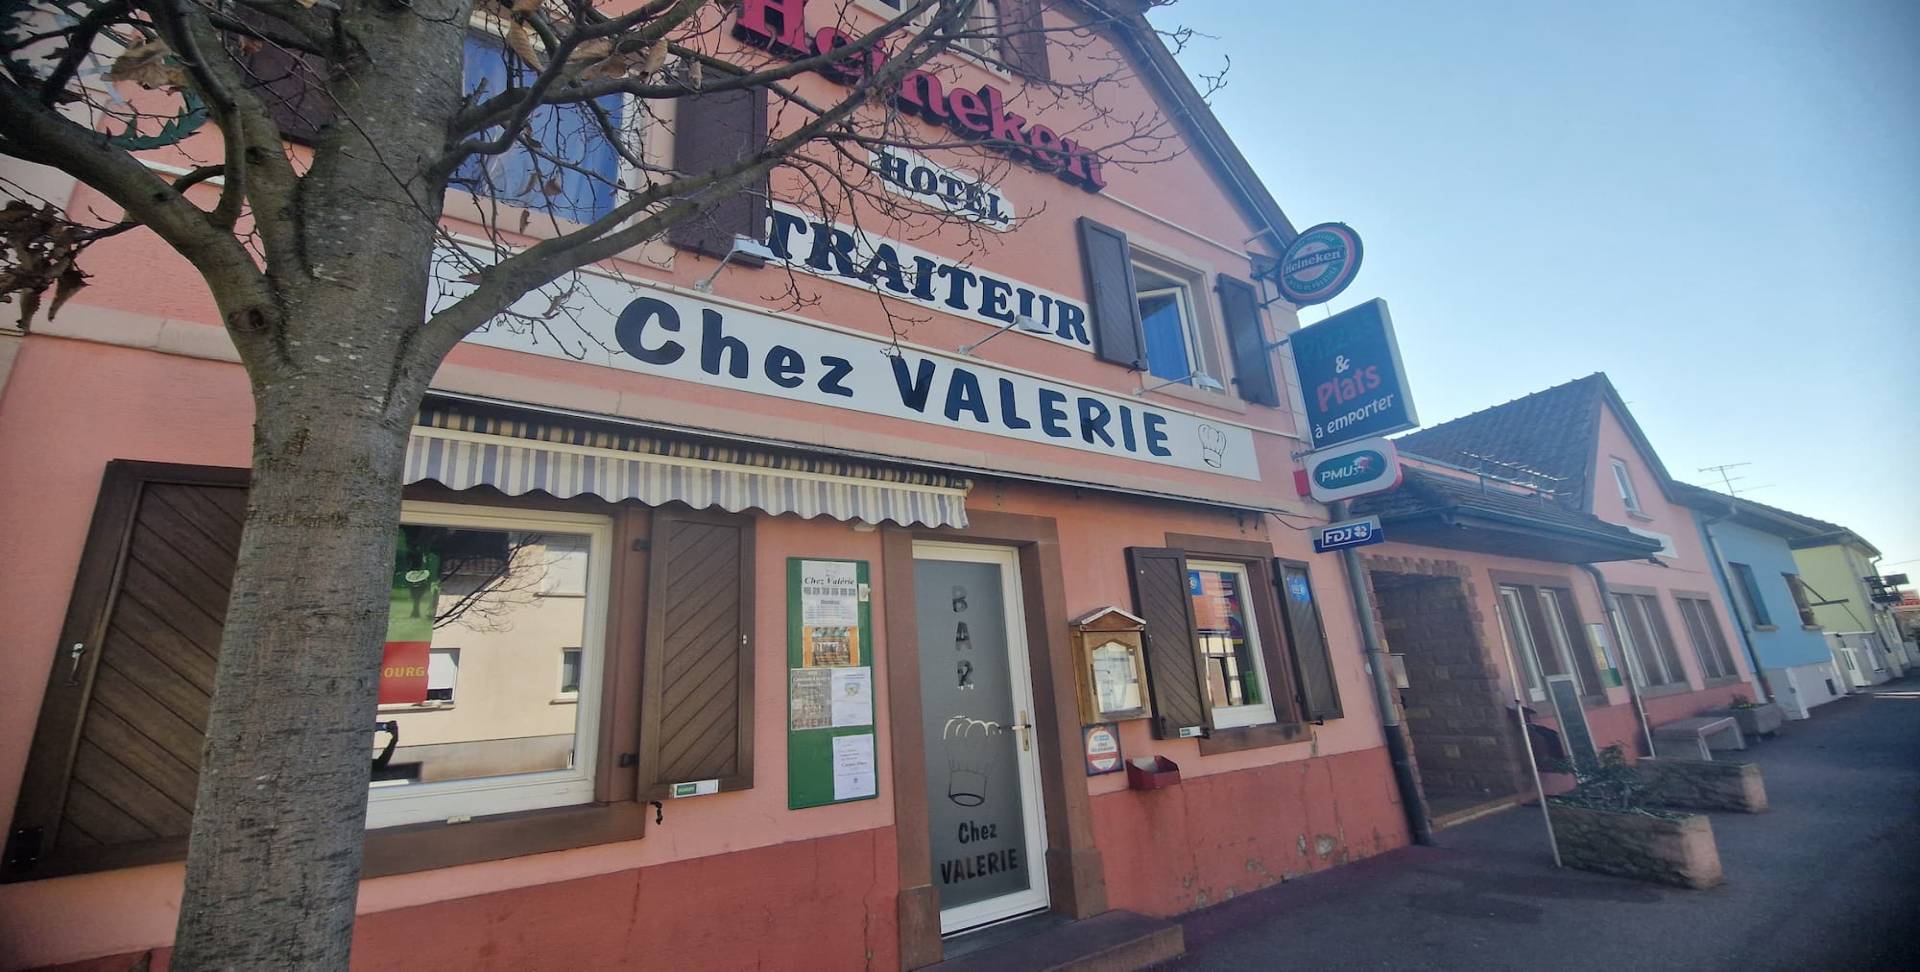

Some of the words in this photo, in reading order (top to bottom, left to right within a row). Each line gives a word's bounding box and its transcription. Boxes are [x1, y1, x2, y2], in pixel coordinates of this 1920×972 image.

[879, 150, 1010, 225] HOTEL
[764, 208, 1091, 346] TRAITEUR
[1285, 249, 1341, 273] Heineken
[615, 296, 853, 398] Chez
[890, 354, 1173, 457] VALERIE
[1335, 355, 1351, 374] &
[1316, 365, 1382, 413] Plats
[1314, 423, 1324, 439] à
[1327, 394, 1395, 434] emporter
[1321, 466, 1353, 483] PMU
[1325, 529, 1353, 545] FDJ
[951, 585, 974, 689] BAR
[958, 820, 998, 845] Chez
[940, 848, 1020, 885] VALERIE
